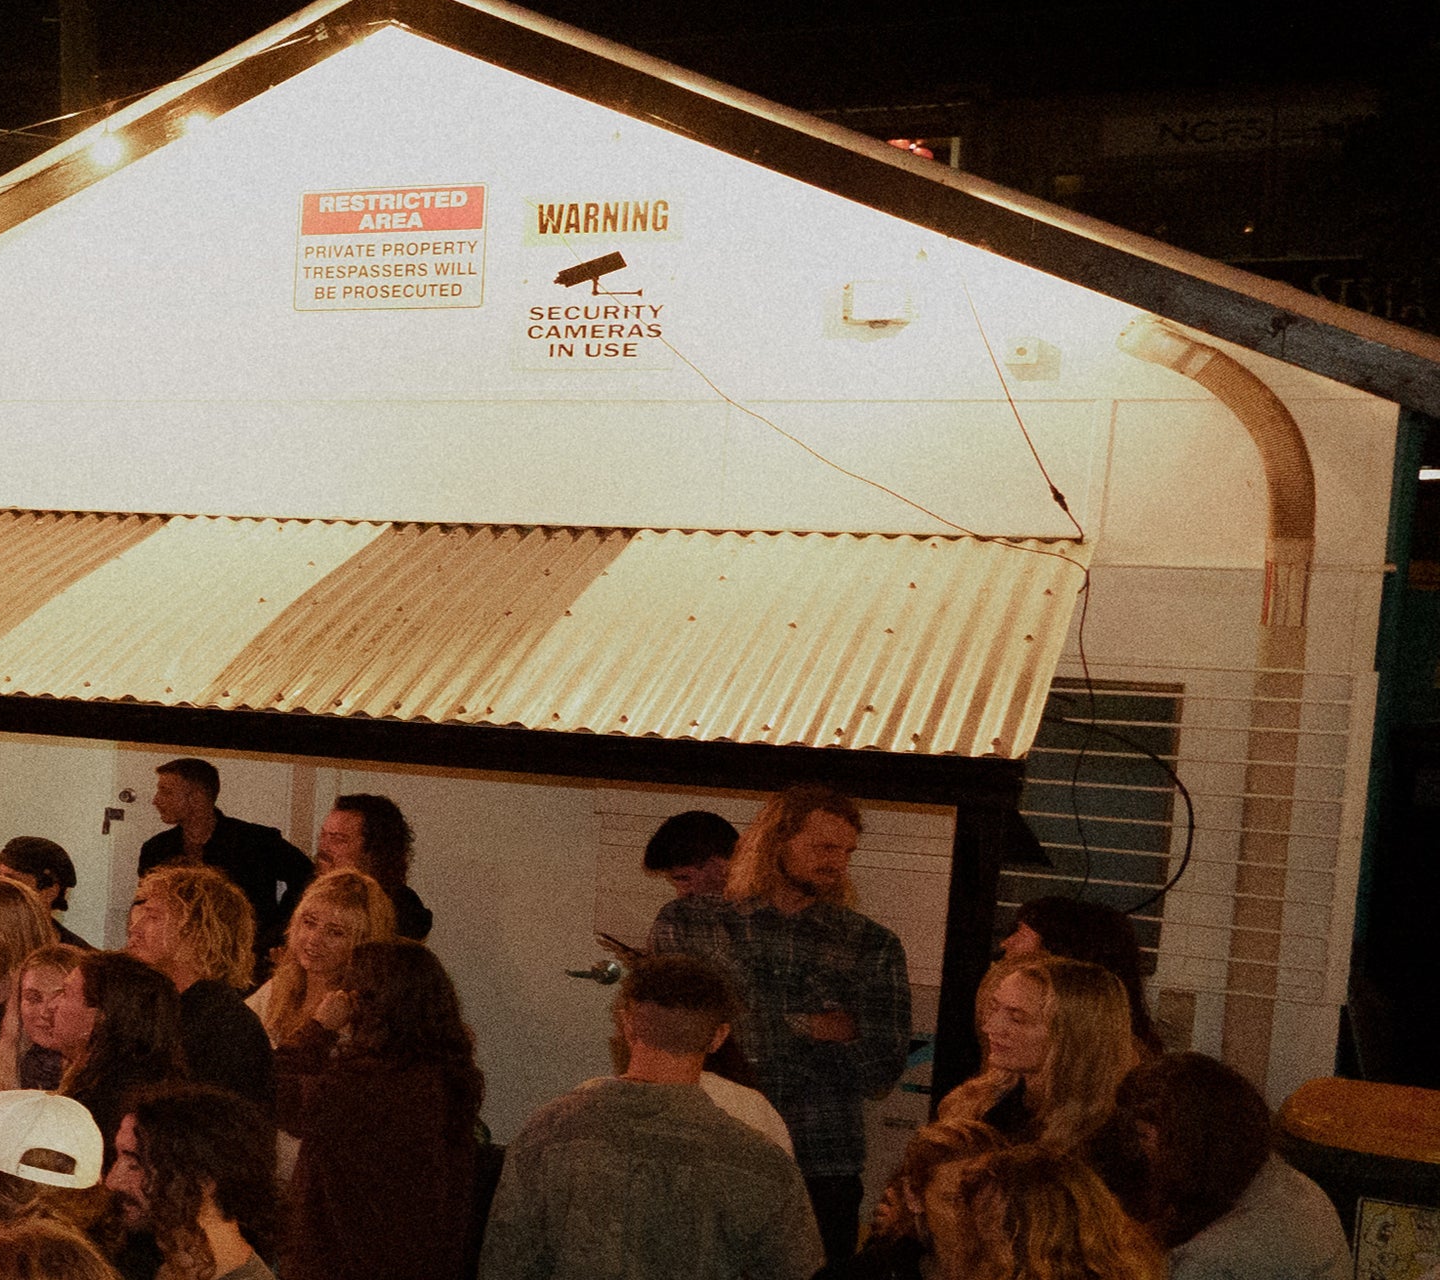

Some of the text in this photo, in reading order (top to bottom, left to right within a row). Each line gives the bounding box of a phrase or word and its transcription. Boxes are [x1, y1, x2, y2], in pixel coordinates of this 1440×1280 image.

[318, 189, 468, 213] RESTRICTED
[358, 211, 424, 231] AREA
[537, 199, 670, 235] WARNING
[304, 240, 479, 260] PRIVATE PROPERTY
[302, 261, 477, 280] TRESPASSERS WILL
[314, 282, 463, 300] BE PROSECUTED
[528, 304, 665, 321] SECURITY
[526, 322, 663, 339] CAMERAS
[548, 342, 639, 358] IN USE
